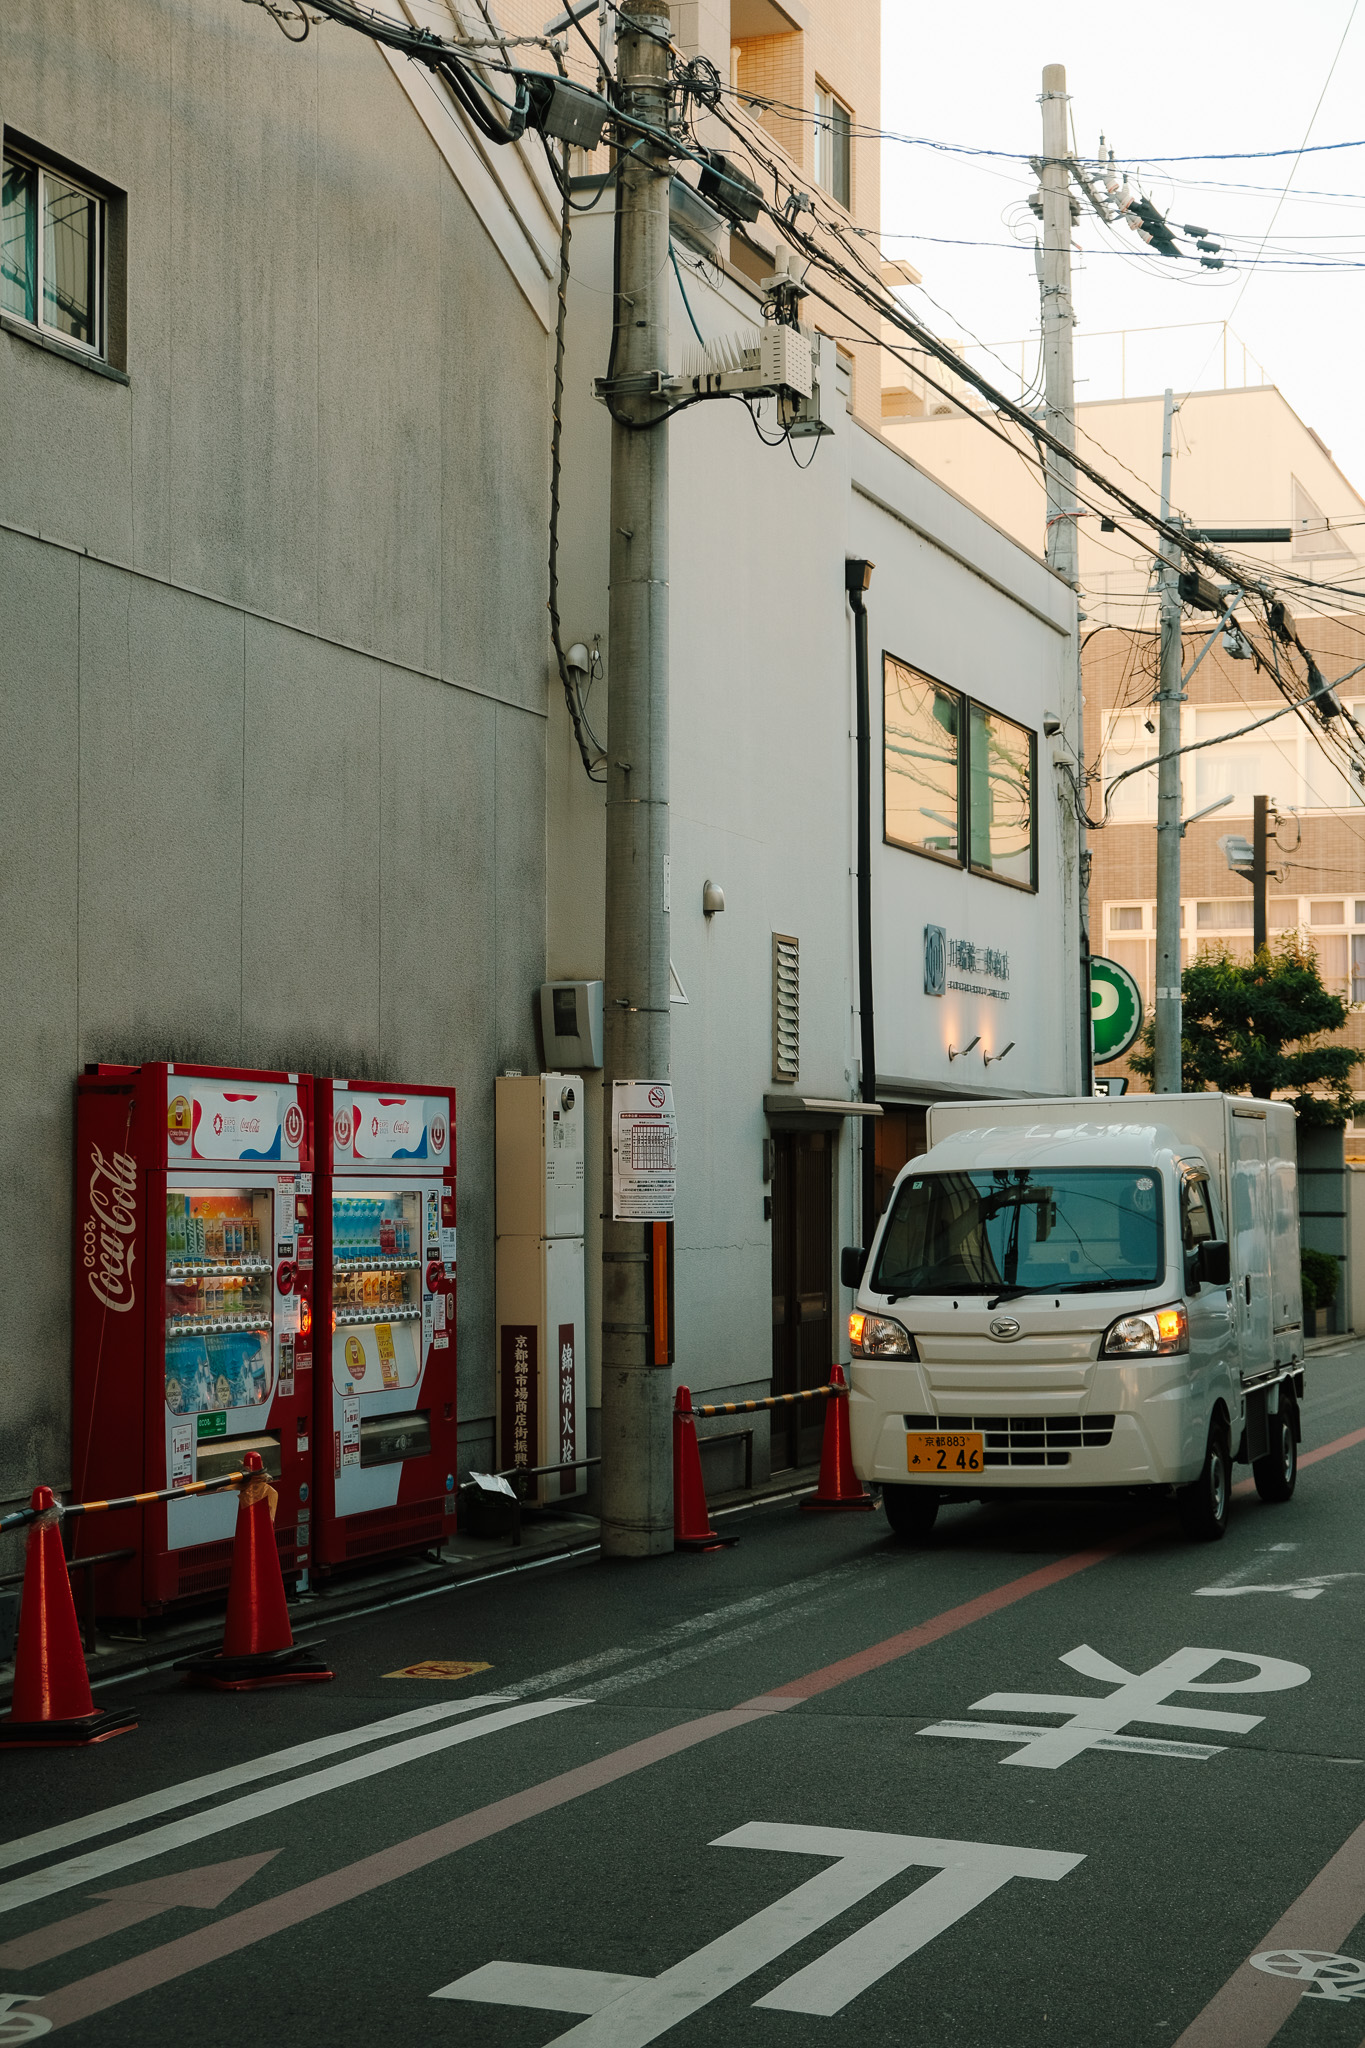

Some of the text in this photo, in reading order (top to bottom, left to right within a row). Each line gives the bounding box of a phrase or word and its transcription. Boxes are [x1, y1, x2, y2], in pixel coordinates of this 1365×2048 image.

[187, 1219, 195, 1253] Sprite
[196, 1219, 205, 1253] Sprite
[514, 1335, 529, 1473] 京都錦市場商店街振興
[561, 1343, 574, 1463] 錦消火栓
[912, 1454, 921, 1464] あ
